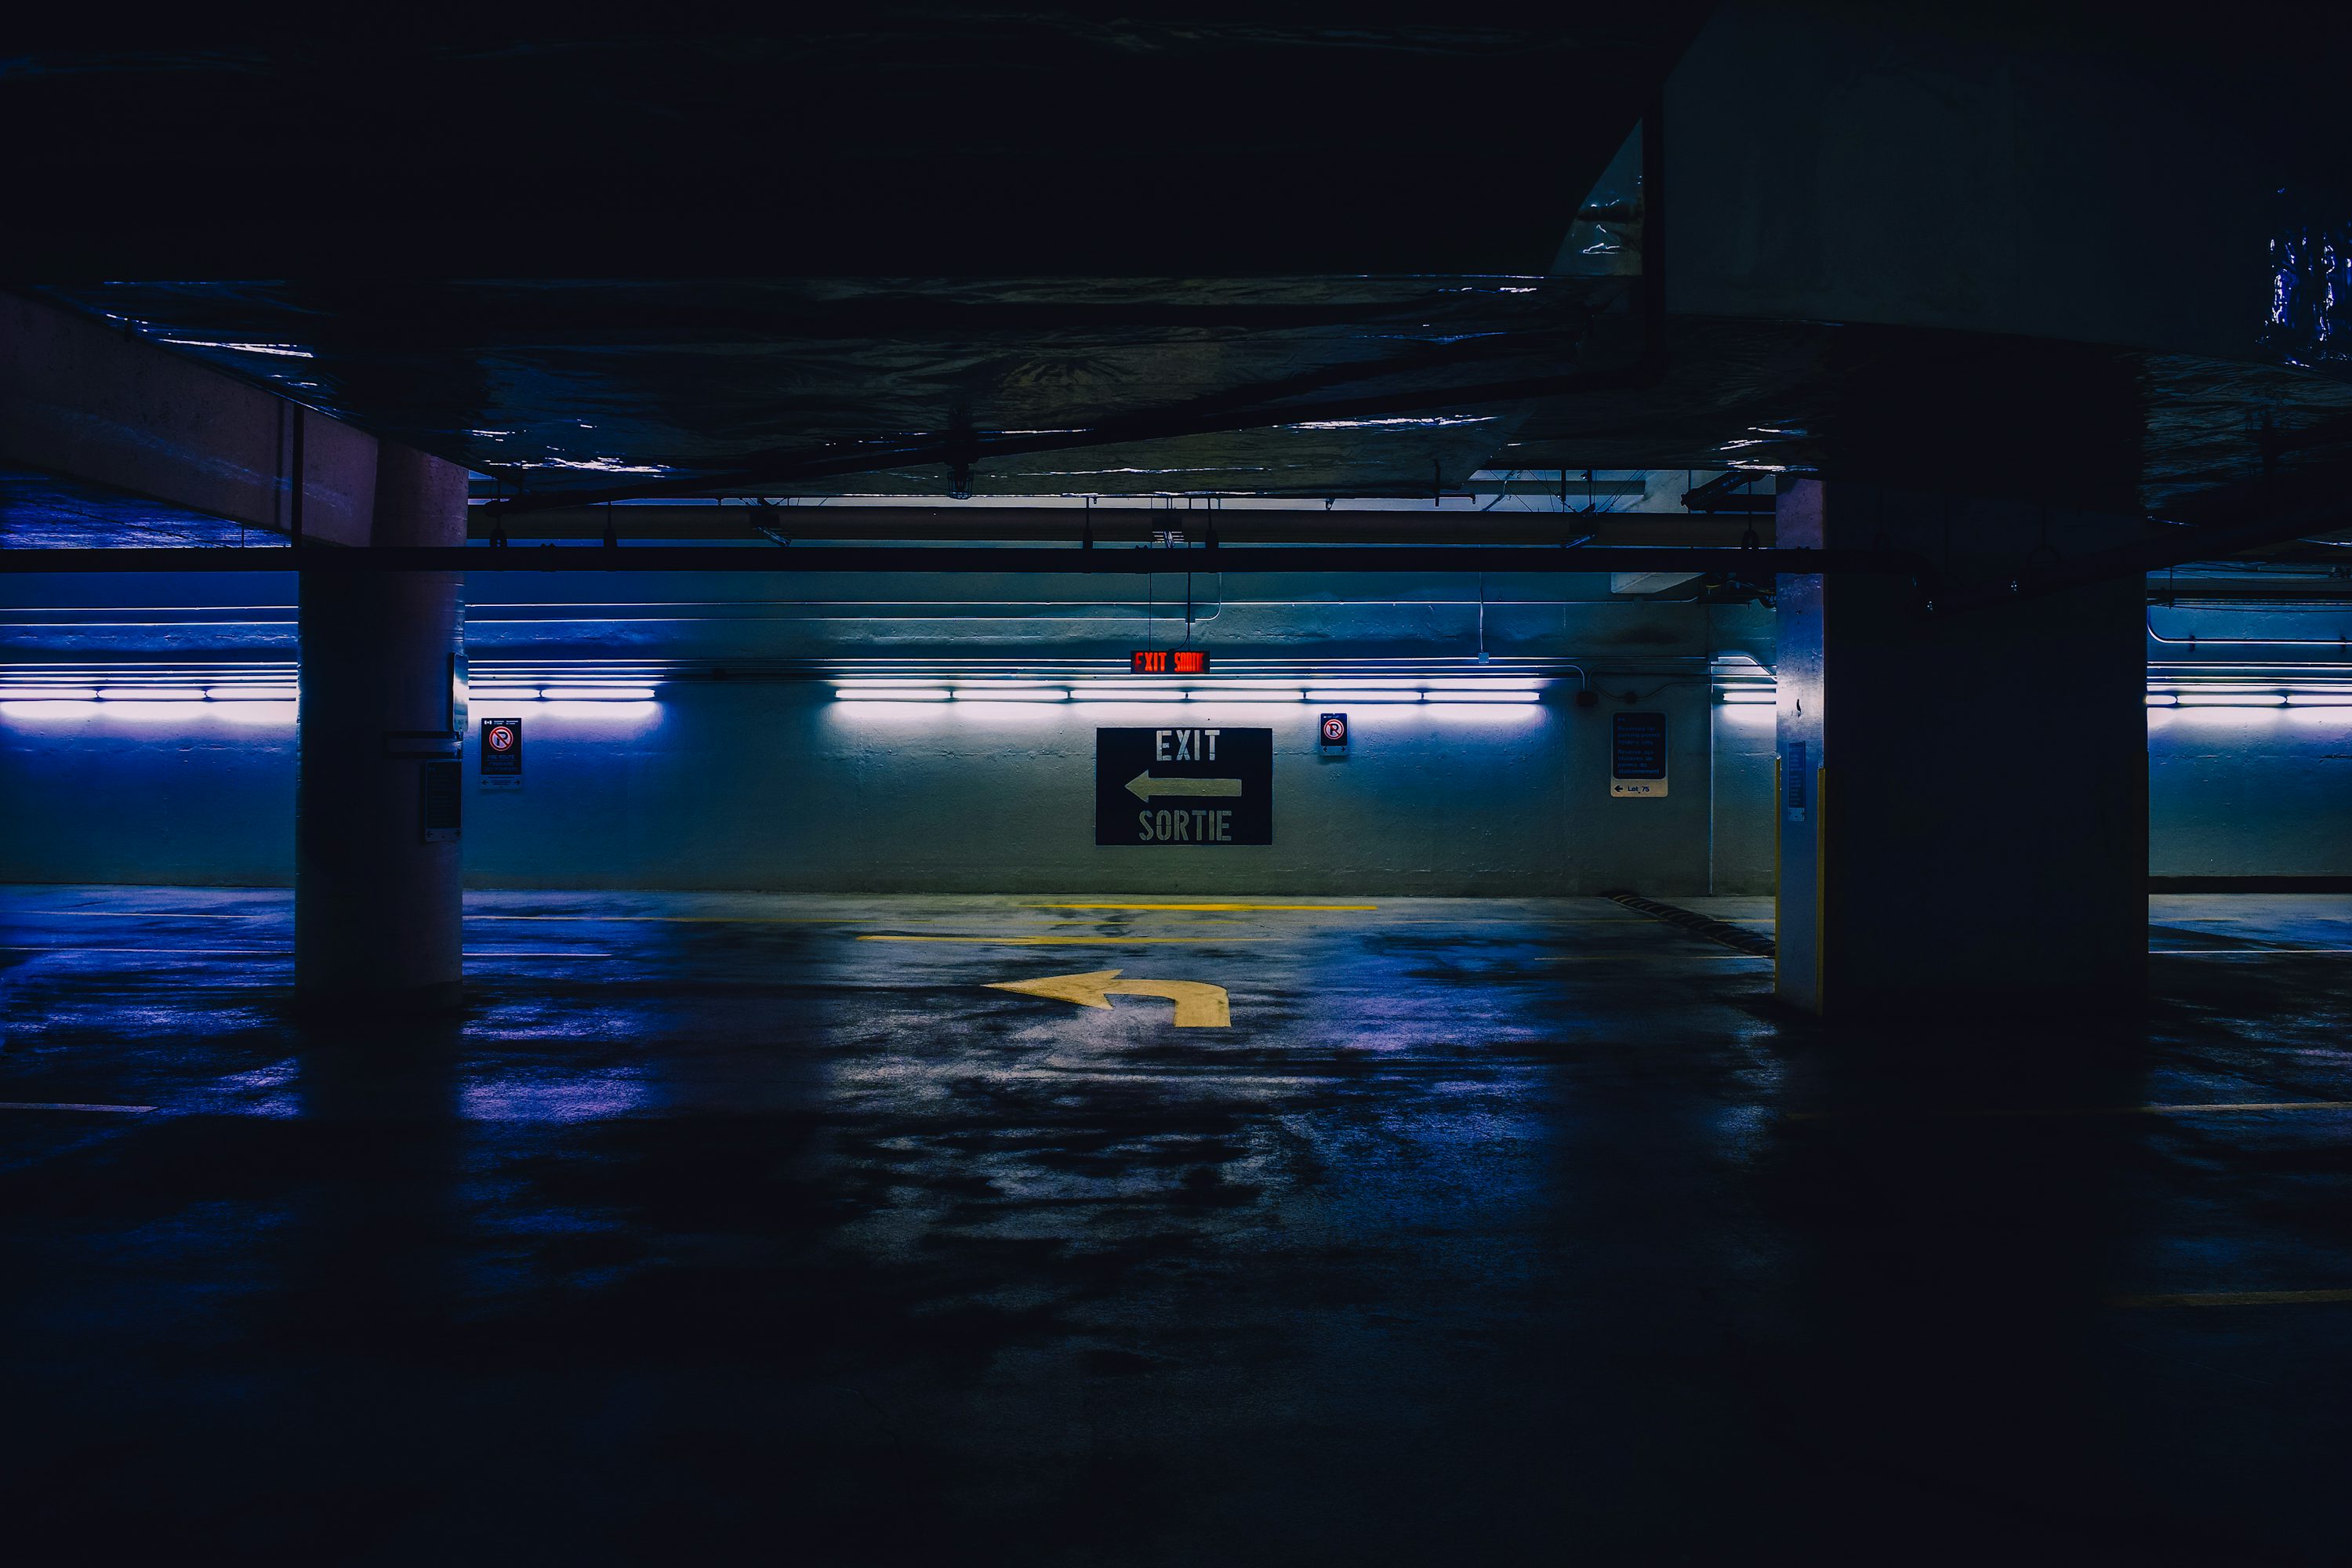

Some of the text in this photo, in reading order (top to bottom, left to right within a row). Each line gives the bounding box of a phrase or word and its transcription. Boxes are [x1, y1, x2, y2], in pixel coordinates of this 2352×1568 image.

[1134, 652, 1167, 672] EXIT
[1156, 729, 1221, 762] EXIT
[1138, 810, 1232, 841] SORTIE
